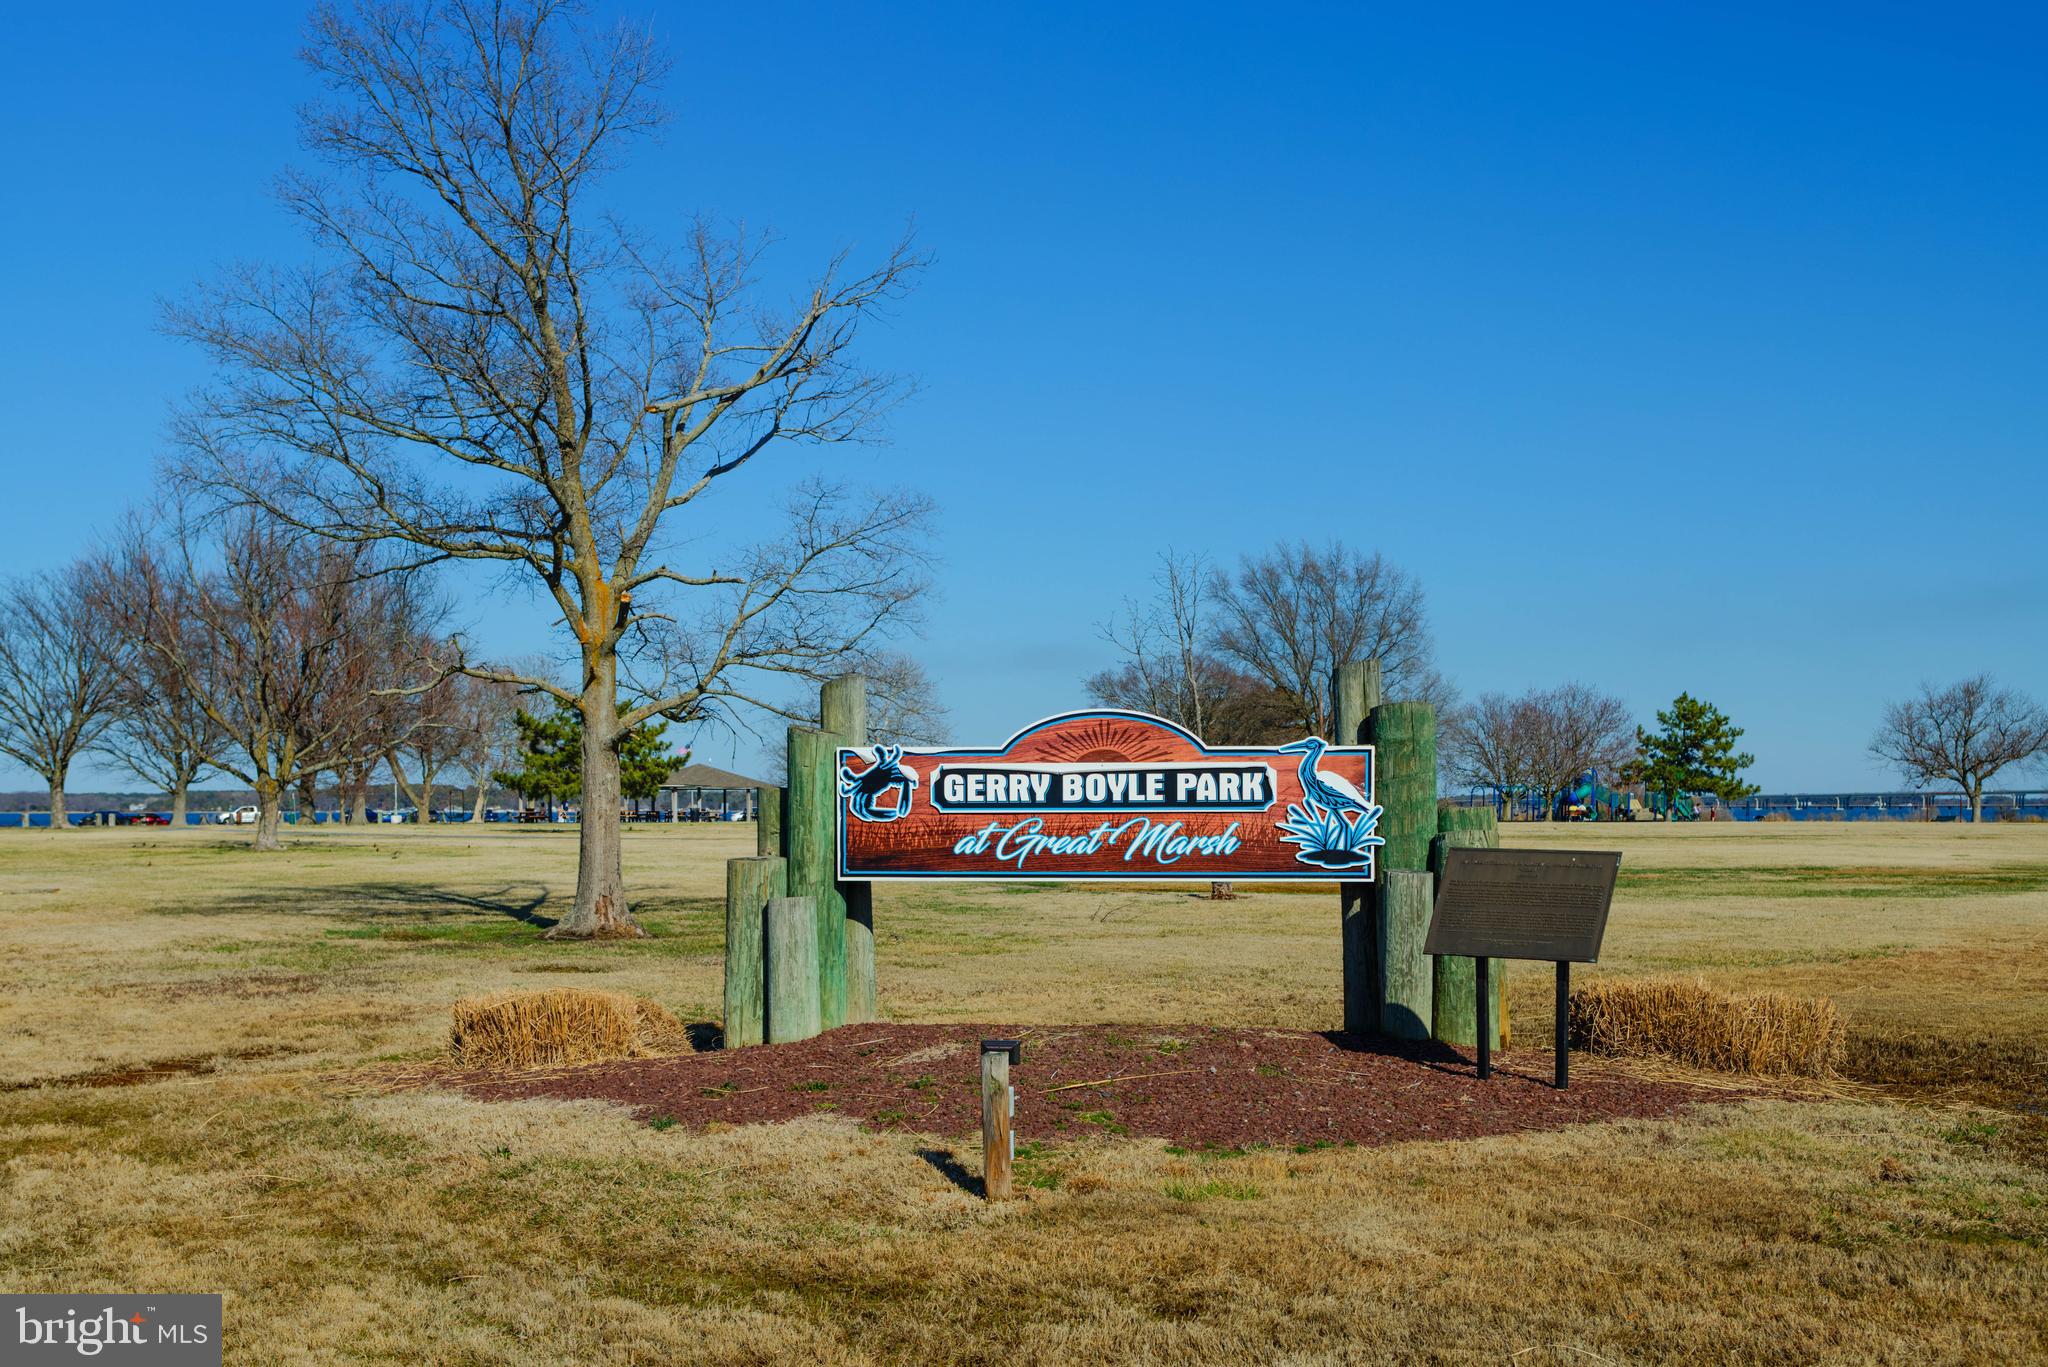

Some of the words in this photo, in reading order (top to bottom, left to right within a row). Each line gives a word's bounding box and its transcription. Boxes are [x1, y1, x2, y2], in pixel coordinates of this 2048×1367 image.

[943, 773, 1051, 803] GERRY
[1062, 772, 1167, 803] BOYLE
[1176, 772, 1266, 803] PARK
[953, 820, 1001, 856] at
[995, 817, 1112, 869] Great
[1109, 817, 1242, 865] Marsh
